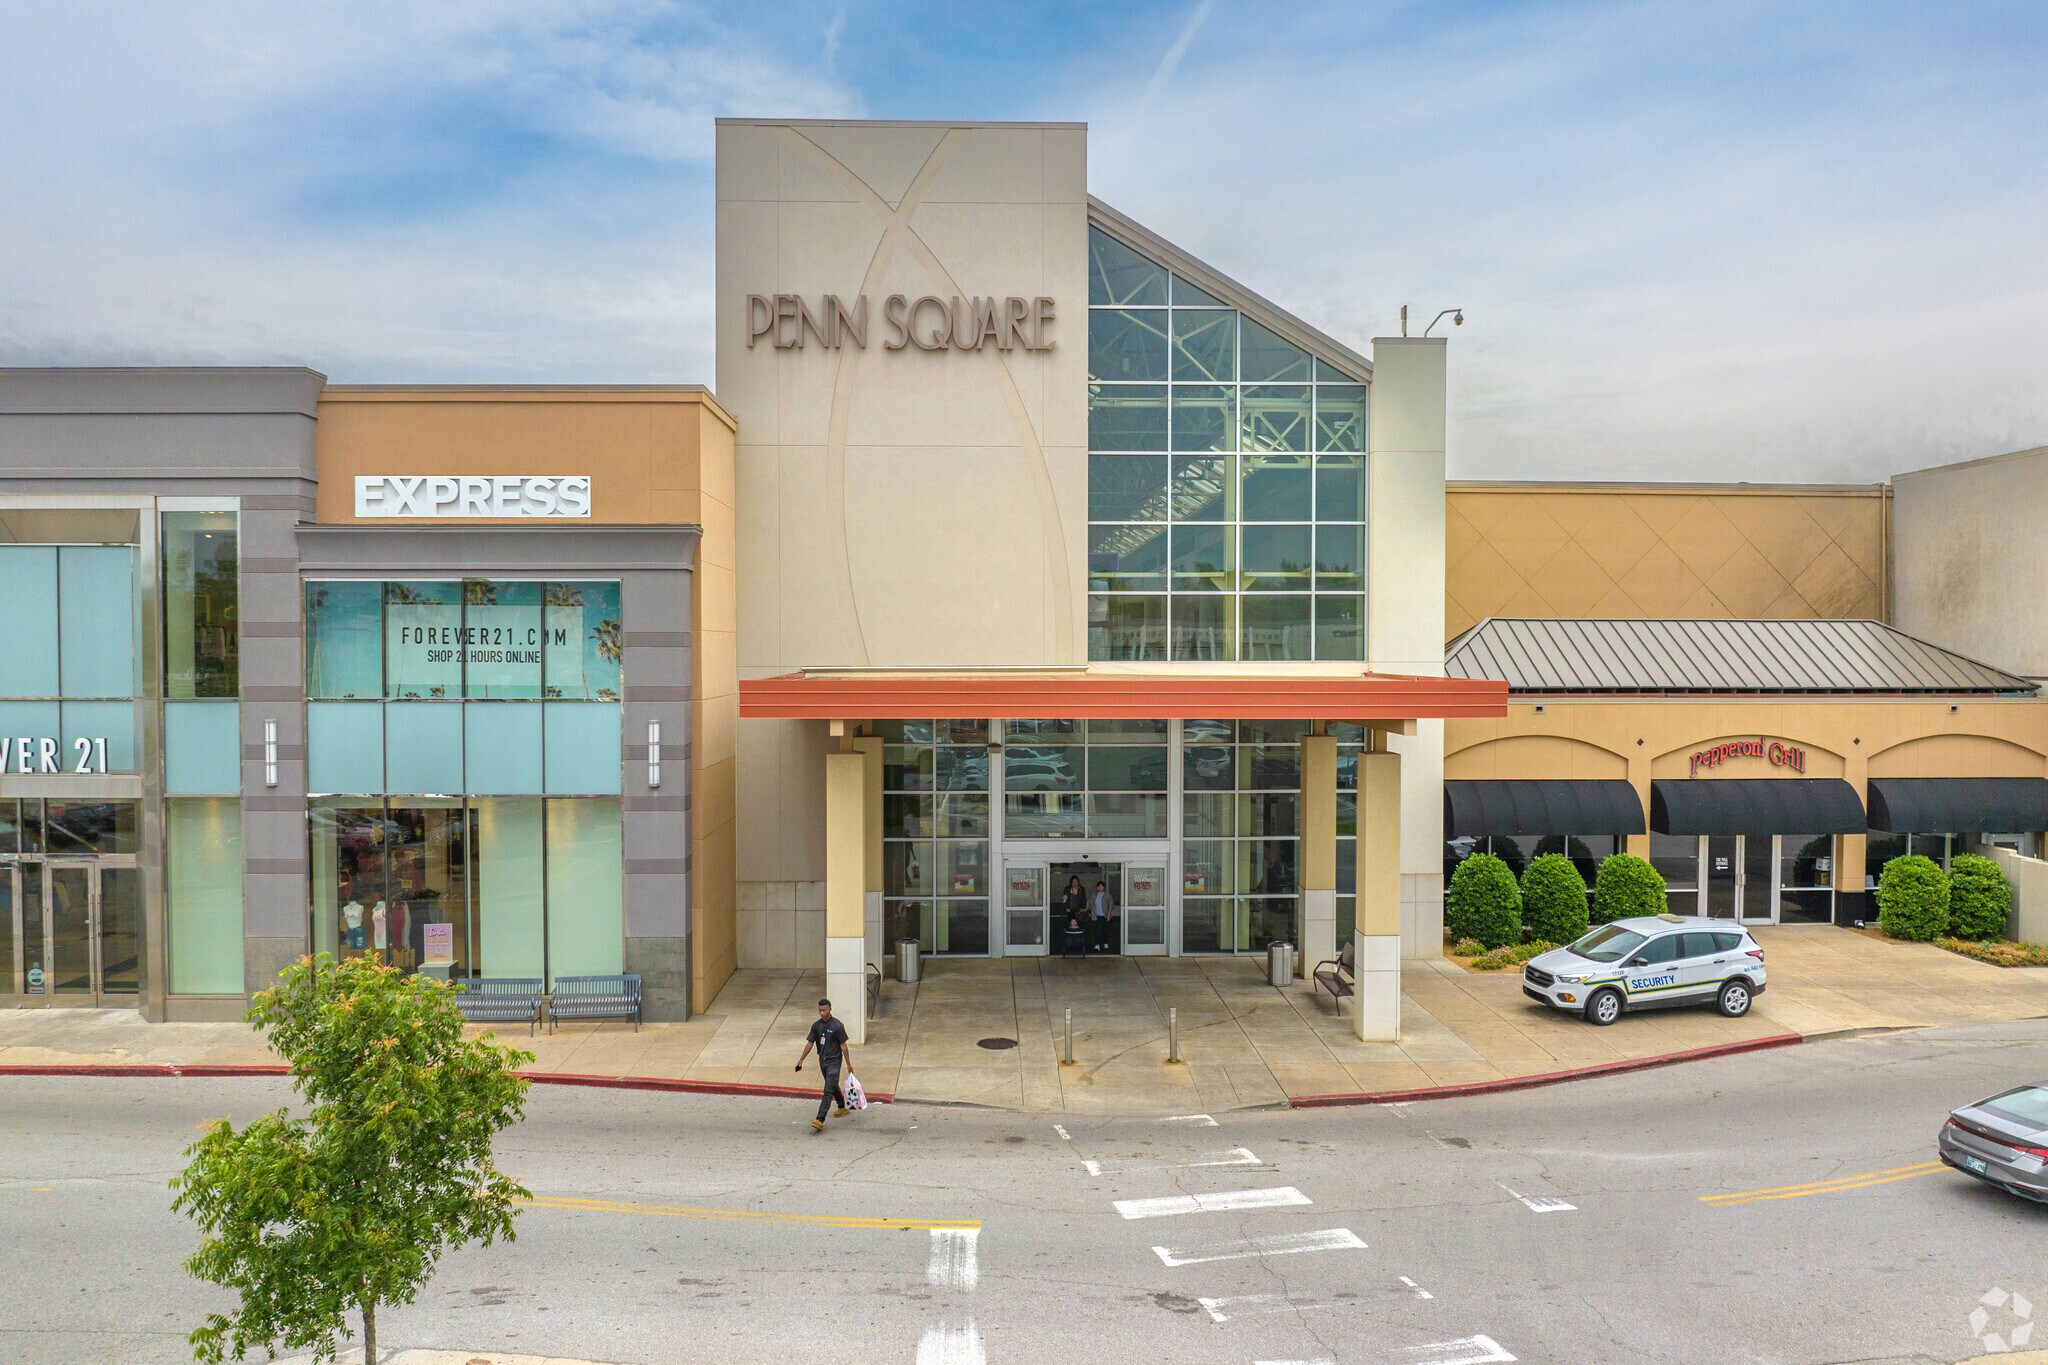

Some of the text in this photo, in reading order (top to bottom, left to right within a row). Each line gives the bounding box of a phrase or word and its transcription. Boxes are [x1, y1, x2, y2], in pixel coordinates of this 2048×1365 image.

[746, 294, 1056, 352] PENN SQUARE
[355, 476, 590, 517] EXPRESS
[427, 650, 540, 663] SHOP 21 HOURS ONLINE
[74, 737, 109, 774] 21
[1768, 742, 1806, 774] Grill
[1631, 975, 1675, 989] SECURITY
